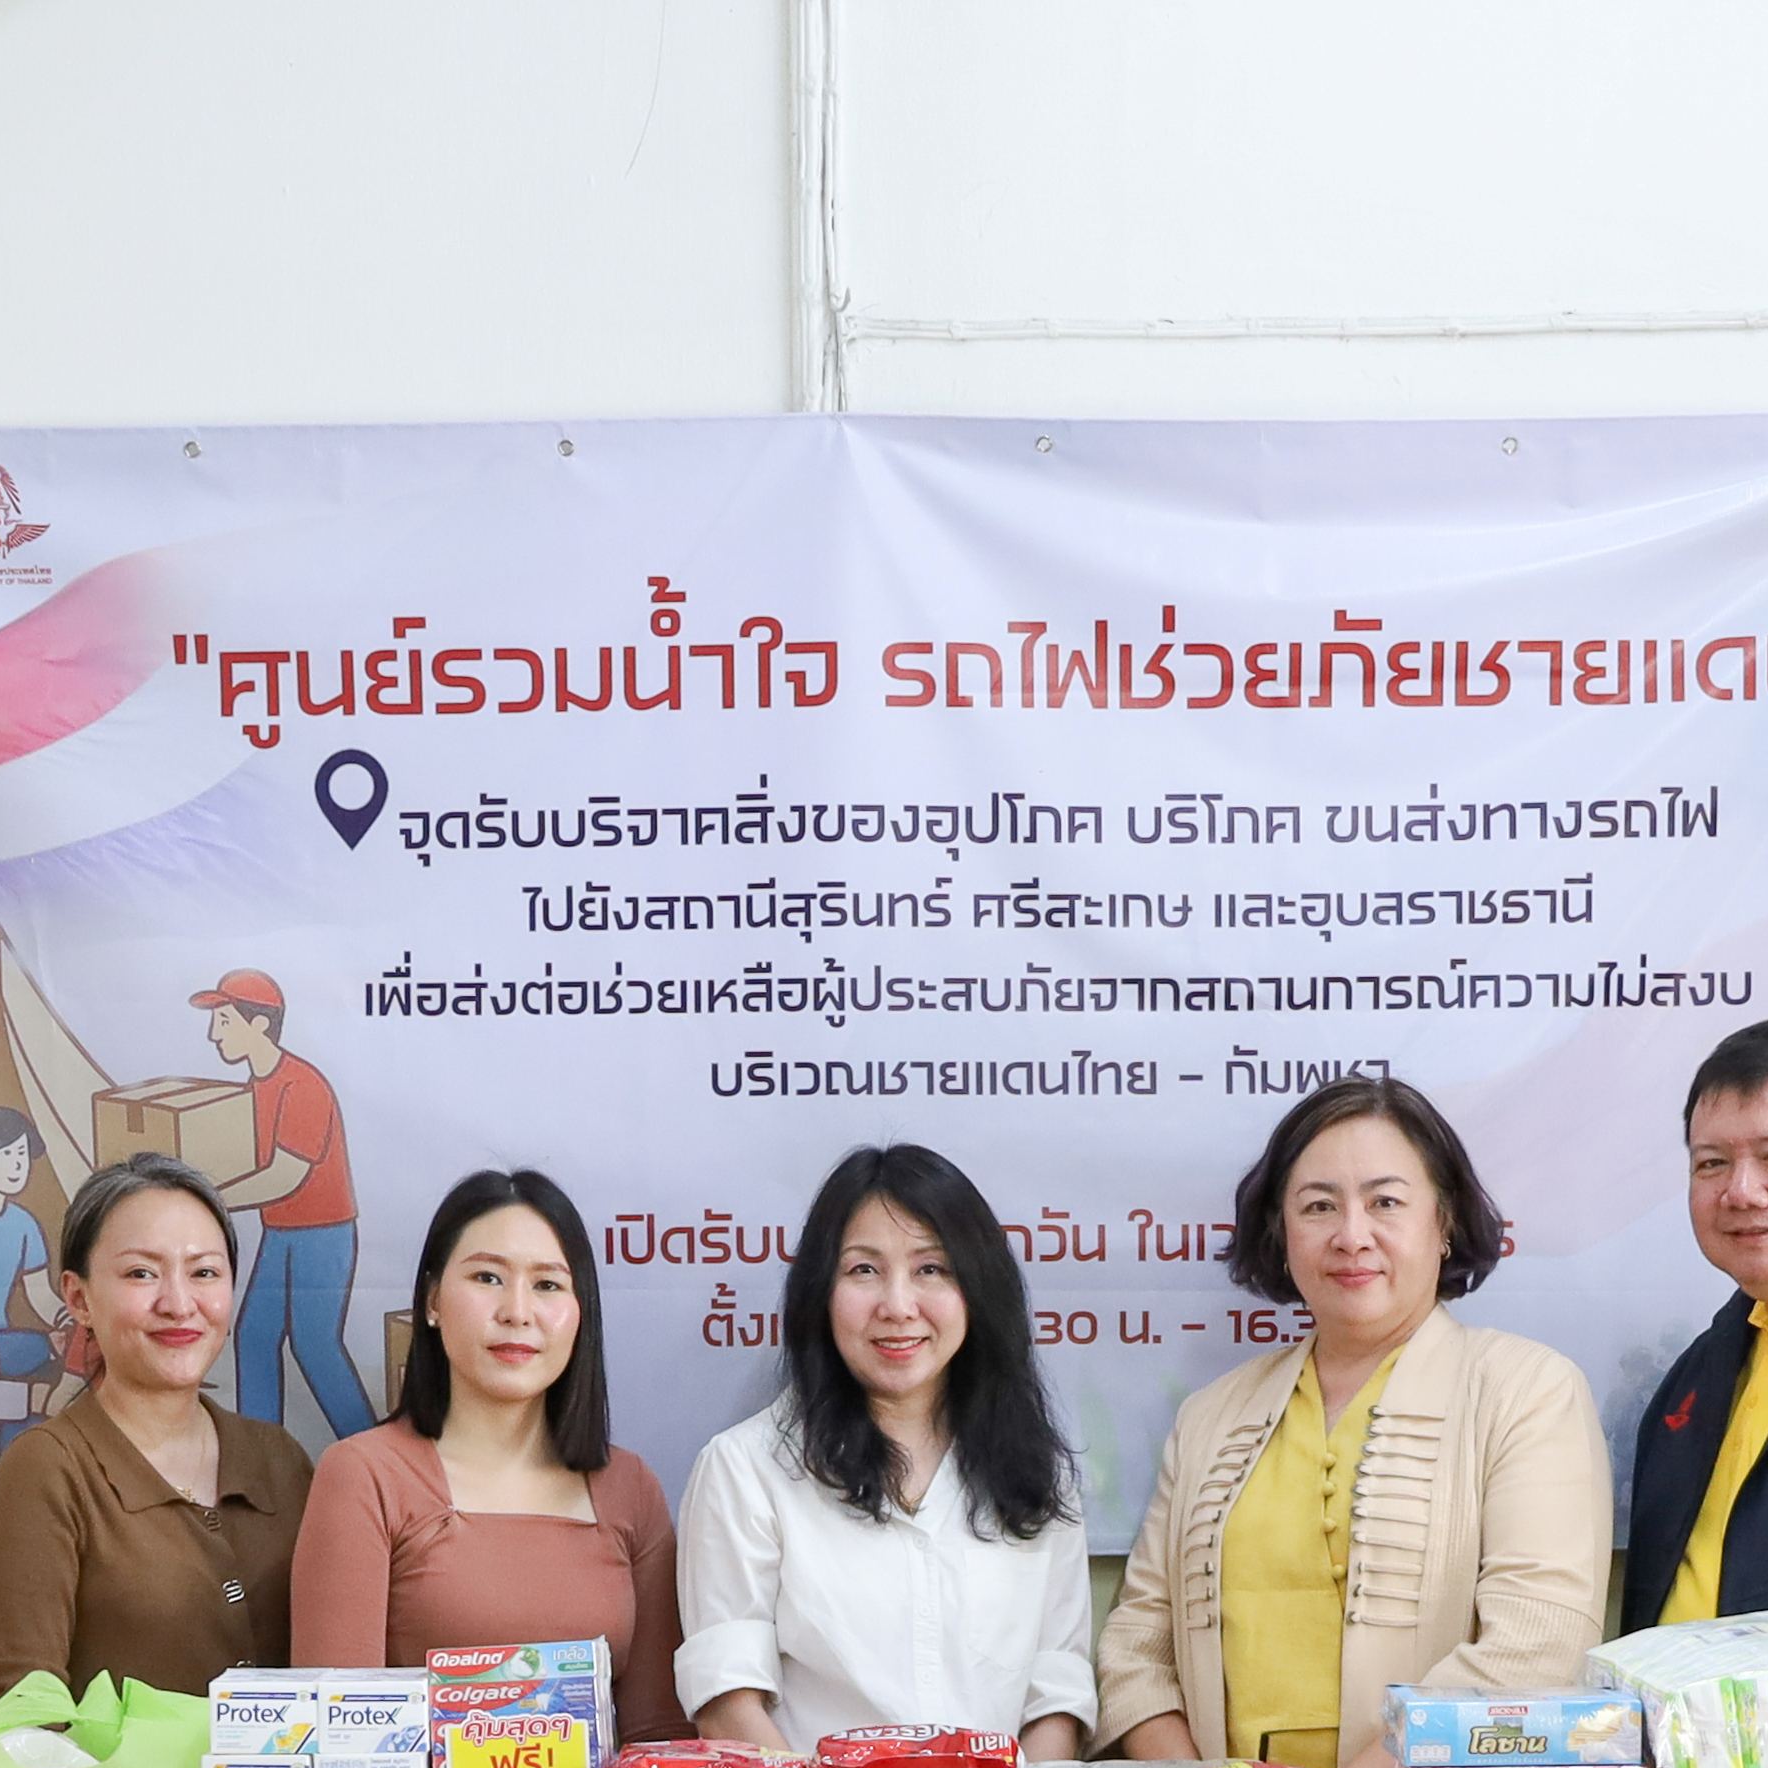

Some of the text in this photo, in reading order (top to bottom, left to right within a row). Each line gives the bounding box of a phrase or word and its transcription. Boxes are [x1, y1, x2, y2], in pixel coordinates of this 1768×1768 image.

[398, 775, 1718, 866] จุดรับบริจาคสิ่งของอุปโภค บริโภค ขนส่งทางรถไฟ
[523, 871, 1594, 944] ไปยังสถานีสุรินทร์ ศรีสะเกษ และอุบลราชธานี
[363, 954, 1753, 1028] เพื่อส่งต่อช่วยเหลือผู้ประสบภัยจากสถานการณ์ความไม่สงบ
[710, 1049, 1157, 1099] บริเวณชายแดนไทย
[1119, 1311, 1162, 1345] น.
[1228, 1309, 1317, 1344] 16.3
[435, 1685, 523, 1705] Colgate
[216, 1703, 290, 1723] Protex
[328, 1706, 402, 1726] Protex
[464, 1713, 571, 1745] คุ้มสุดๆ
[1469, 1725, 1548, 1755] โลซาน
